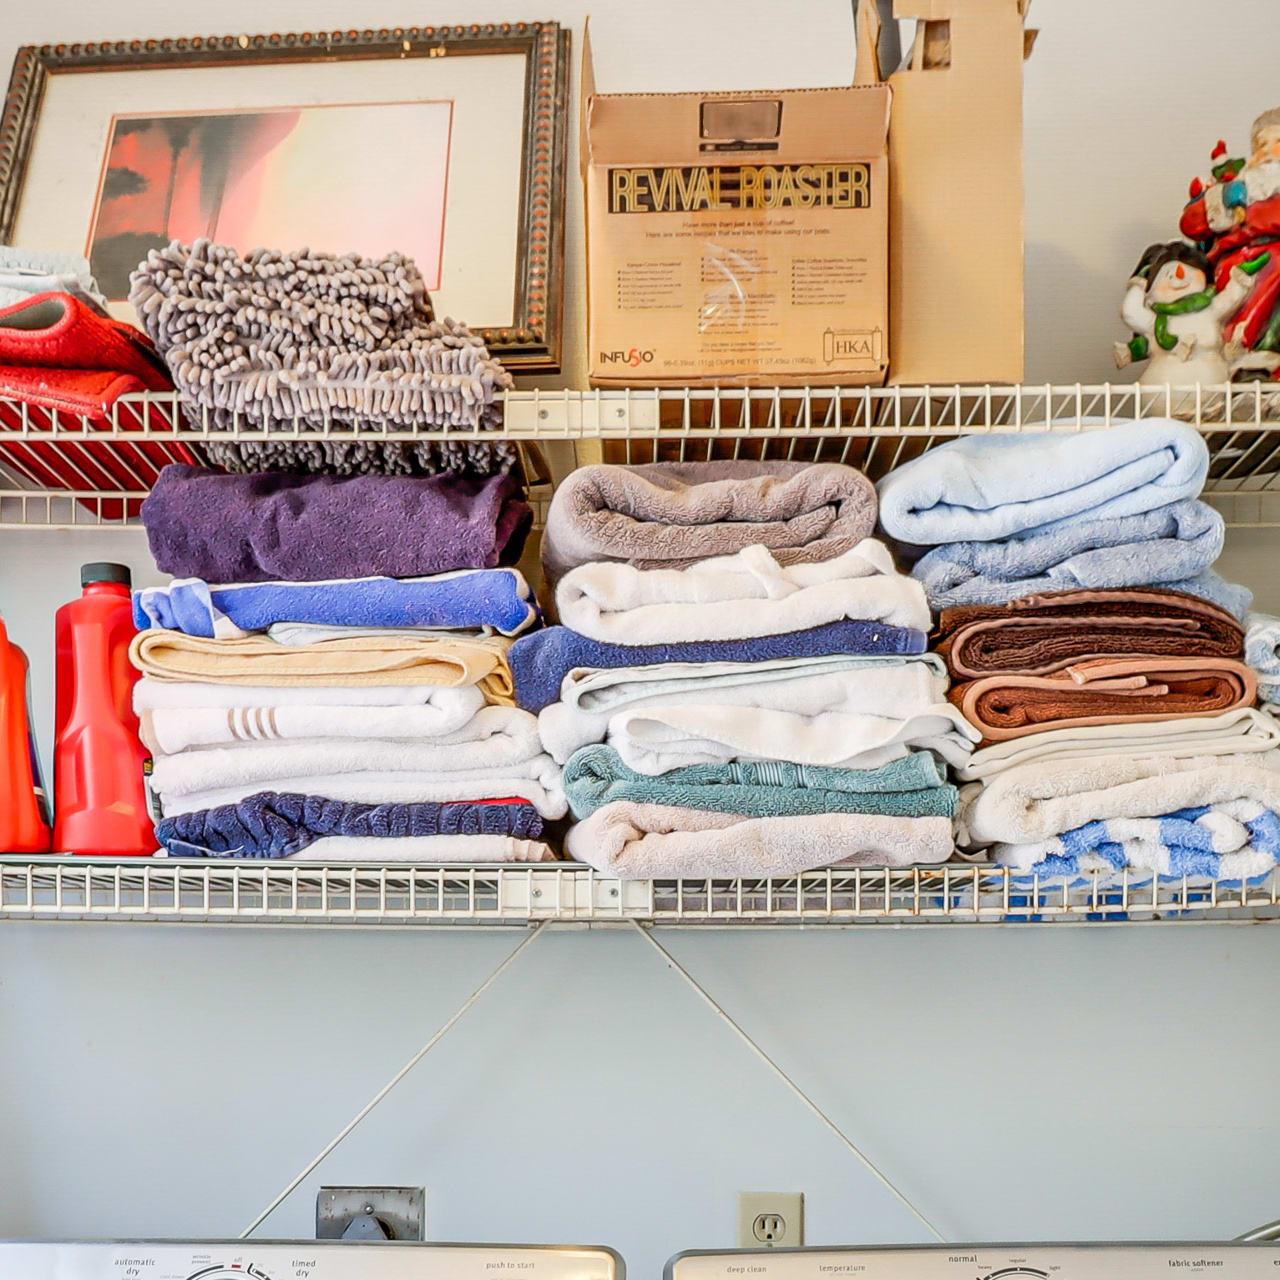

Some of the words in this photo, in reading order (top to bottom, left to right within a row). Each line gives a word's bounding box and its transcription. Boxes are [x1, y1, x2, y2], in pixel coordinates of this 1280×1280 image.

[612, 167, 733, 213] REVIVAL
[738, 163, 869, 209] ROASTER
[835, 340, 871, 354] HKA
[114, 1258, 156, 1267] automatic
[948, 1254, 978, 1263] normal
[292, 1259, 316, 1268] timed
[486, 1261, 506, 1270] push
[507, 1261, 515, 1269] to
[1168, 1259, 1191, 1268] fabric
[1192, 1259, 1224, 1267] softener
[126, 1267, 140, 1277] dry
[295, 1268, 310, 1278] dry
[726, 1264, 746, 1274] deep
[746, 1264, 767, 1273] clean
[819, 1264, 866, 1273] temperature
